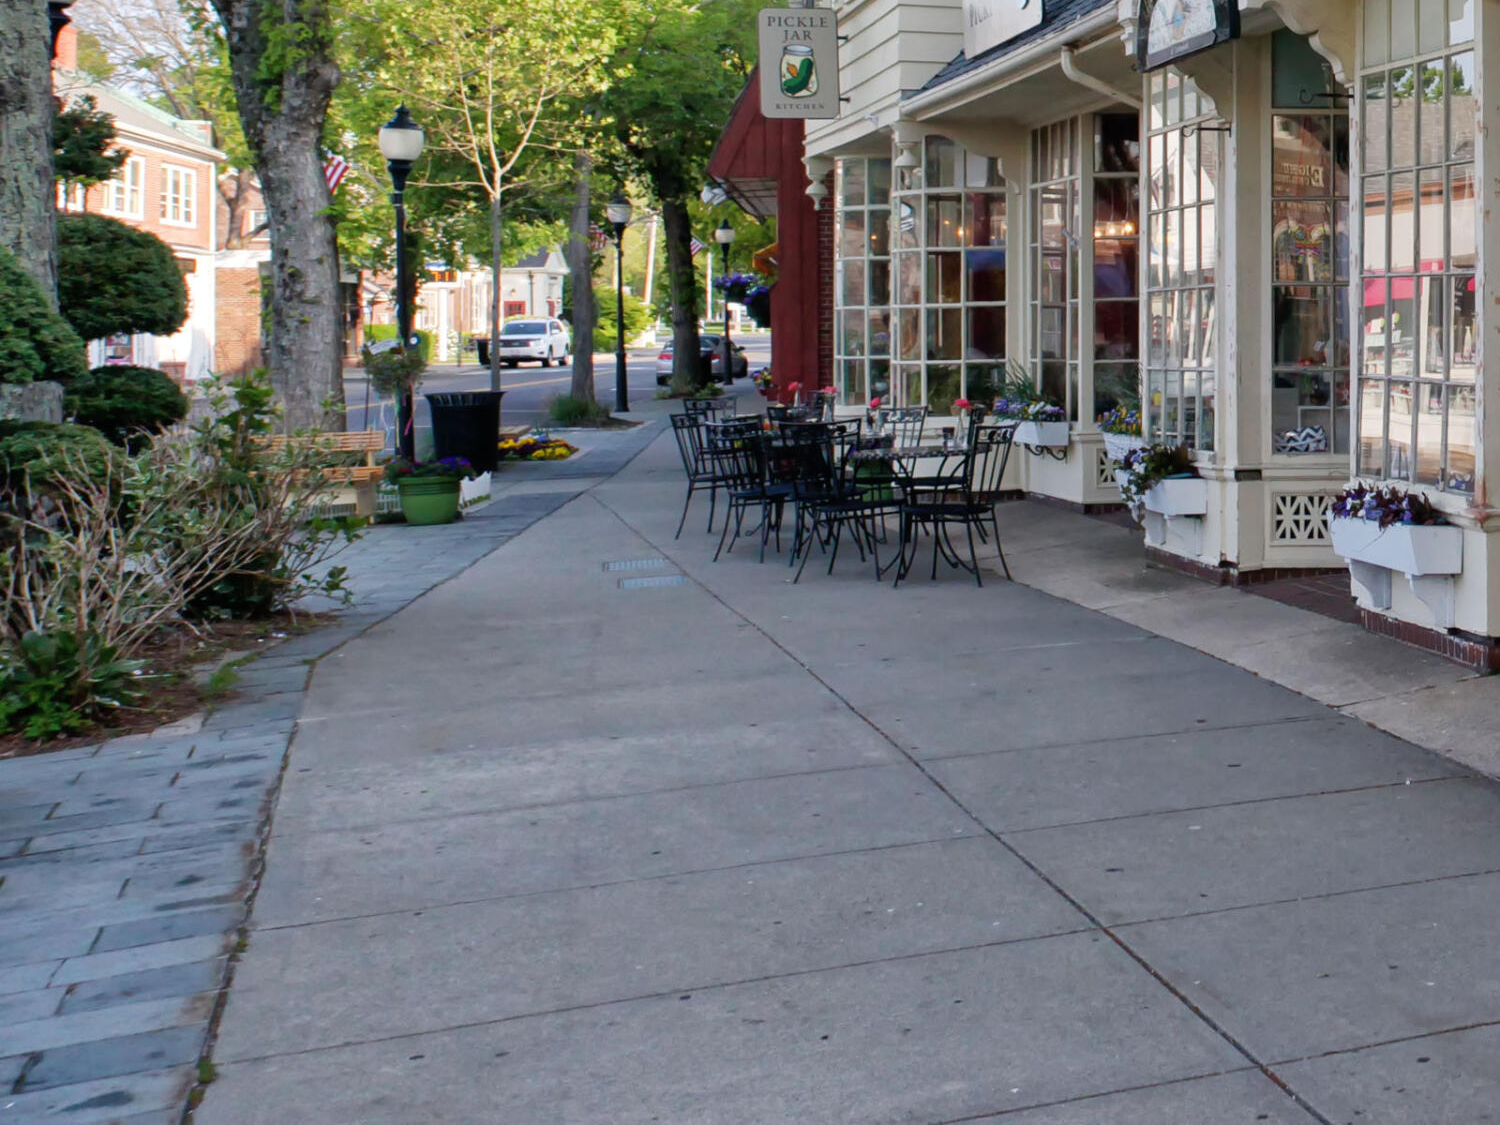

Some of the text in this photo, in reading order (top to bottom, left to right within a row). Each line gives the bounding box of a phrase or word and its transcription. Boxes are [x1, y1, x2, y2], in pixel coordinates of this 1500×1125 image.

[767, 16, 829, 28] PICKLE
[782, 29, 813, 43] JAR
[775, 103, 825, 111] KITCHEN
